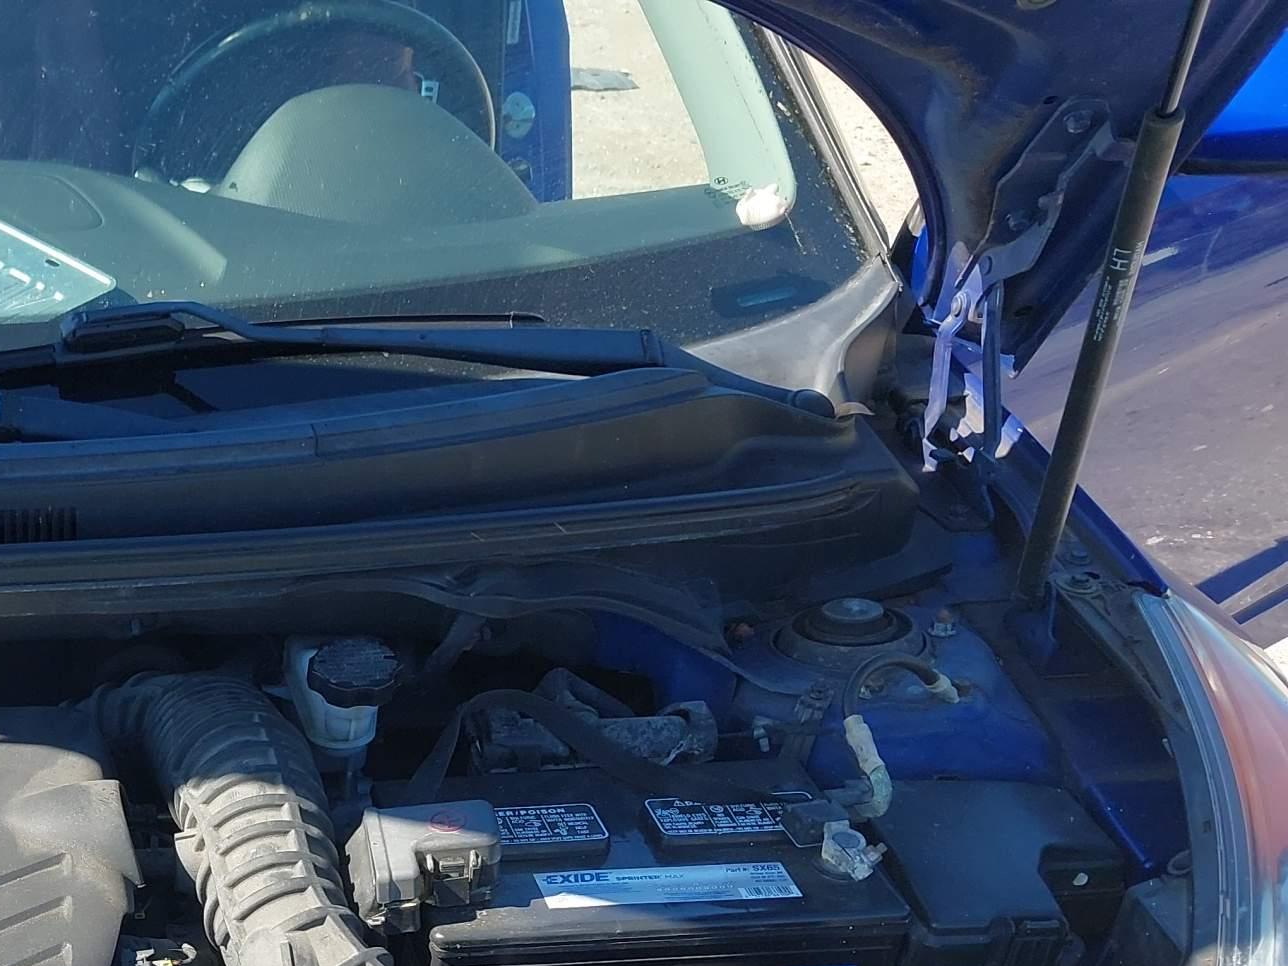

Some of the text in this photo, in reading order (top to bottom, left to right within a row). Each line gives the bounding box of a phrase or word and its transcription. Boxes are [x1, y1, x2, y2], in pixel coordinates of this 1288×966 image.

[1110, 249, 1130, 271] LH
[495, 808, 565, 817] ER/POISON
[544, 872, 609, 885] EXIDE
[752, 864, 780, 872] SX65
